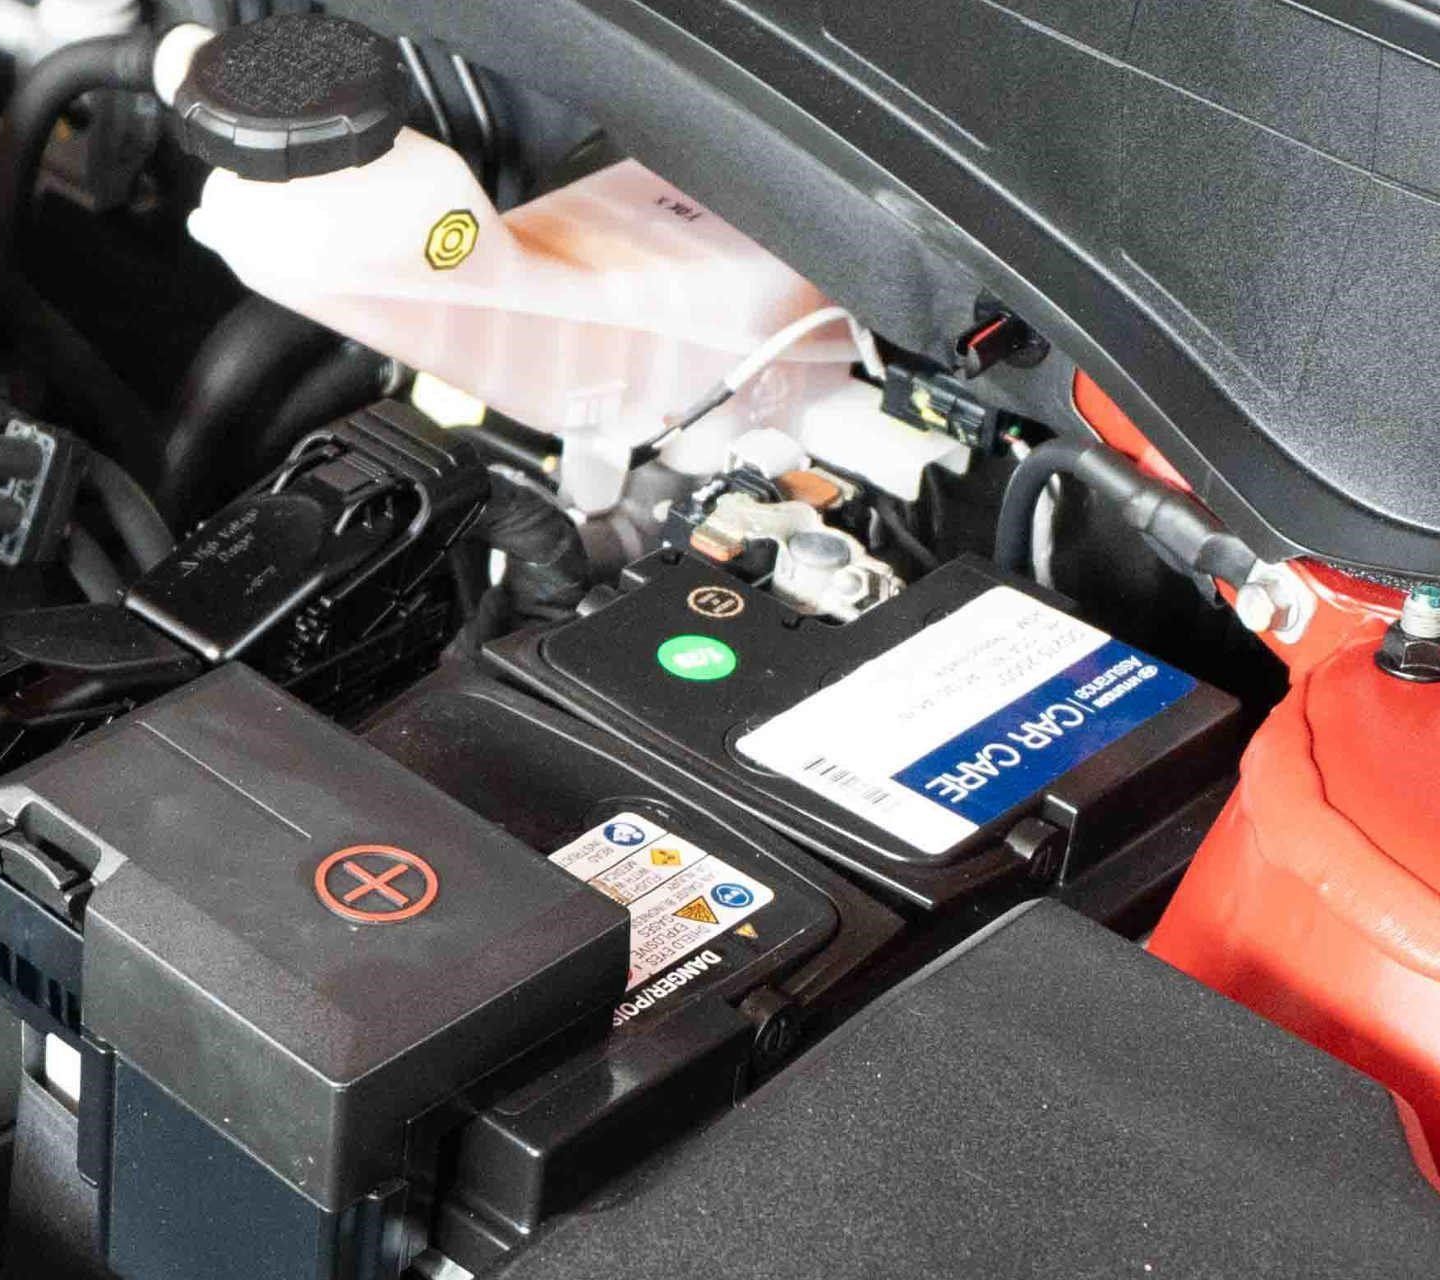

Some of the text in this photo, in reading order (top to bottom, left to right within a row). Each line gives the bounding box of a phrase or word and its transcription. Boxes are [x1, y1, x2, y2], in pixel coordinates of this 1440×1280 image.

[1075, 655, 1143, 700] Assurance
[925, 704, 1084, 803] CAR CARE
[629, 921, 688, 959] EXPLOSIVE
[635, 913, 676, 938] GASES
[667, 923, 711, 950] SHIELD
